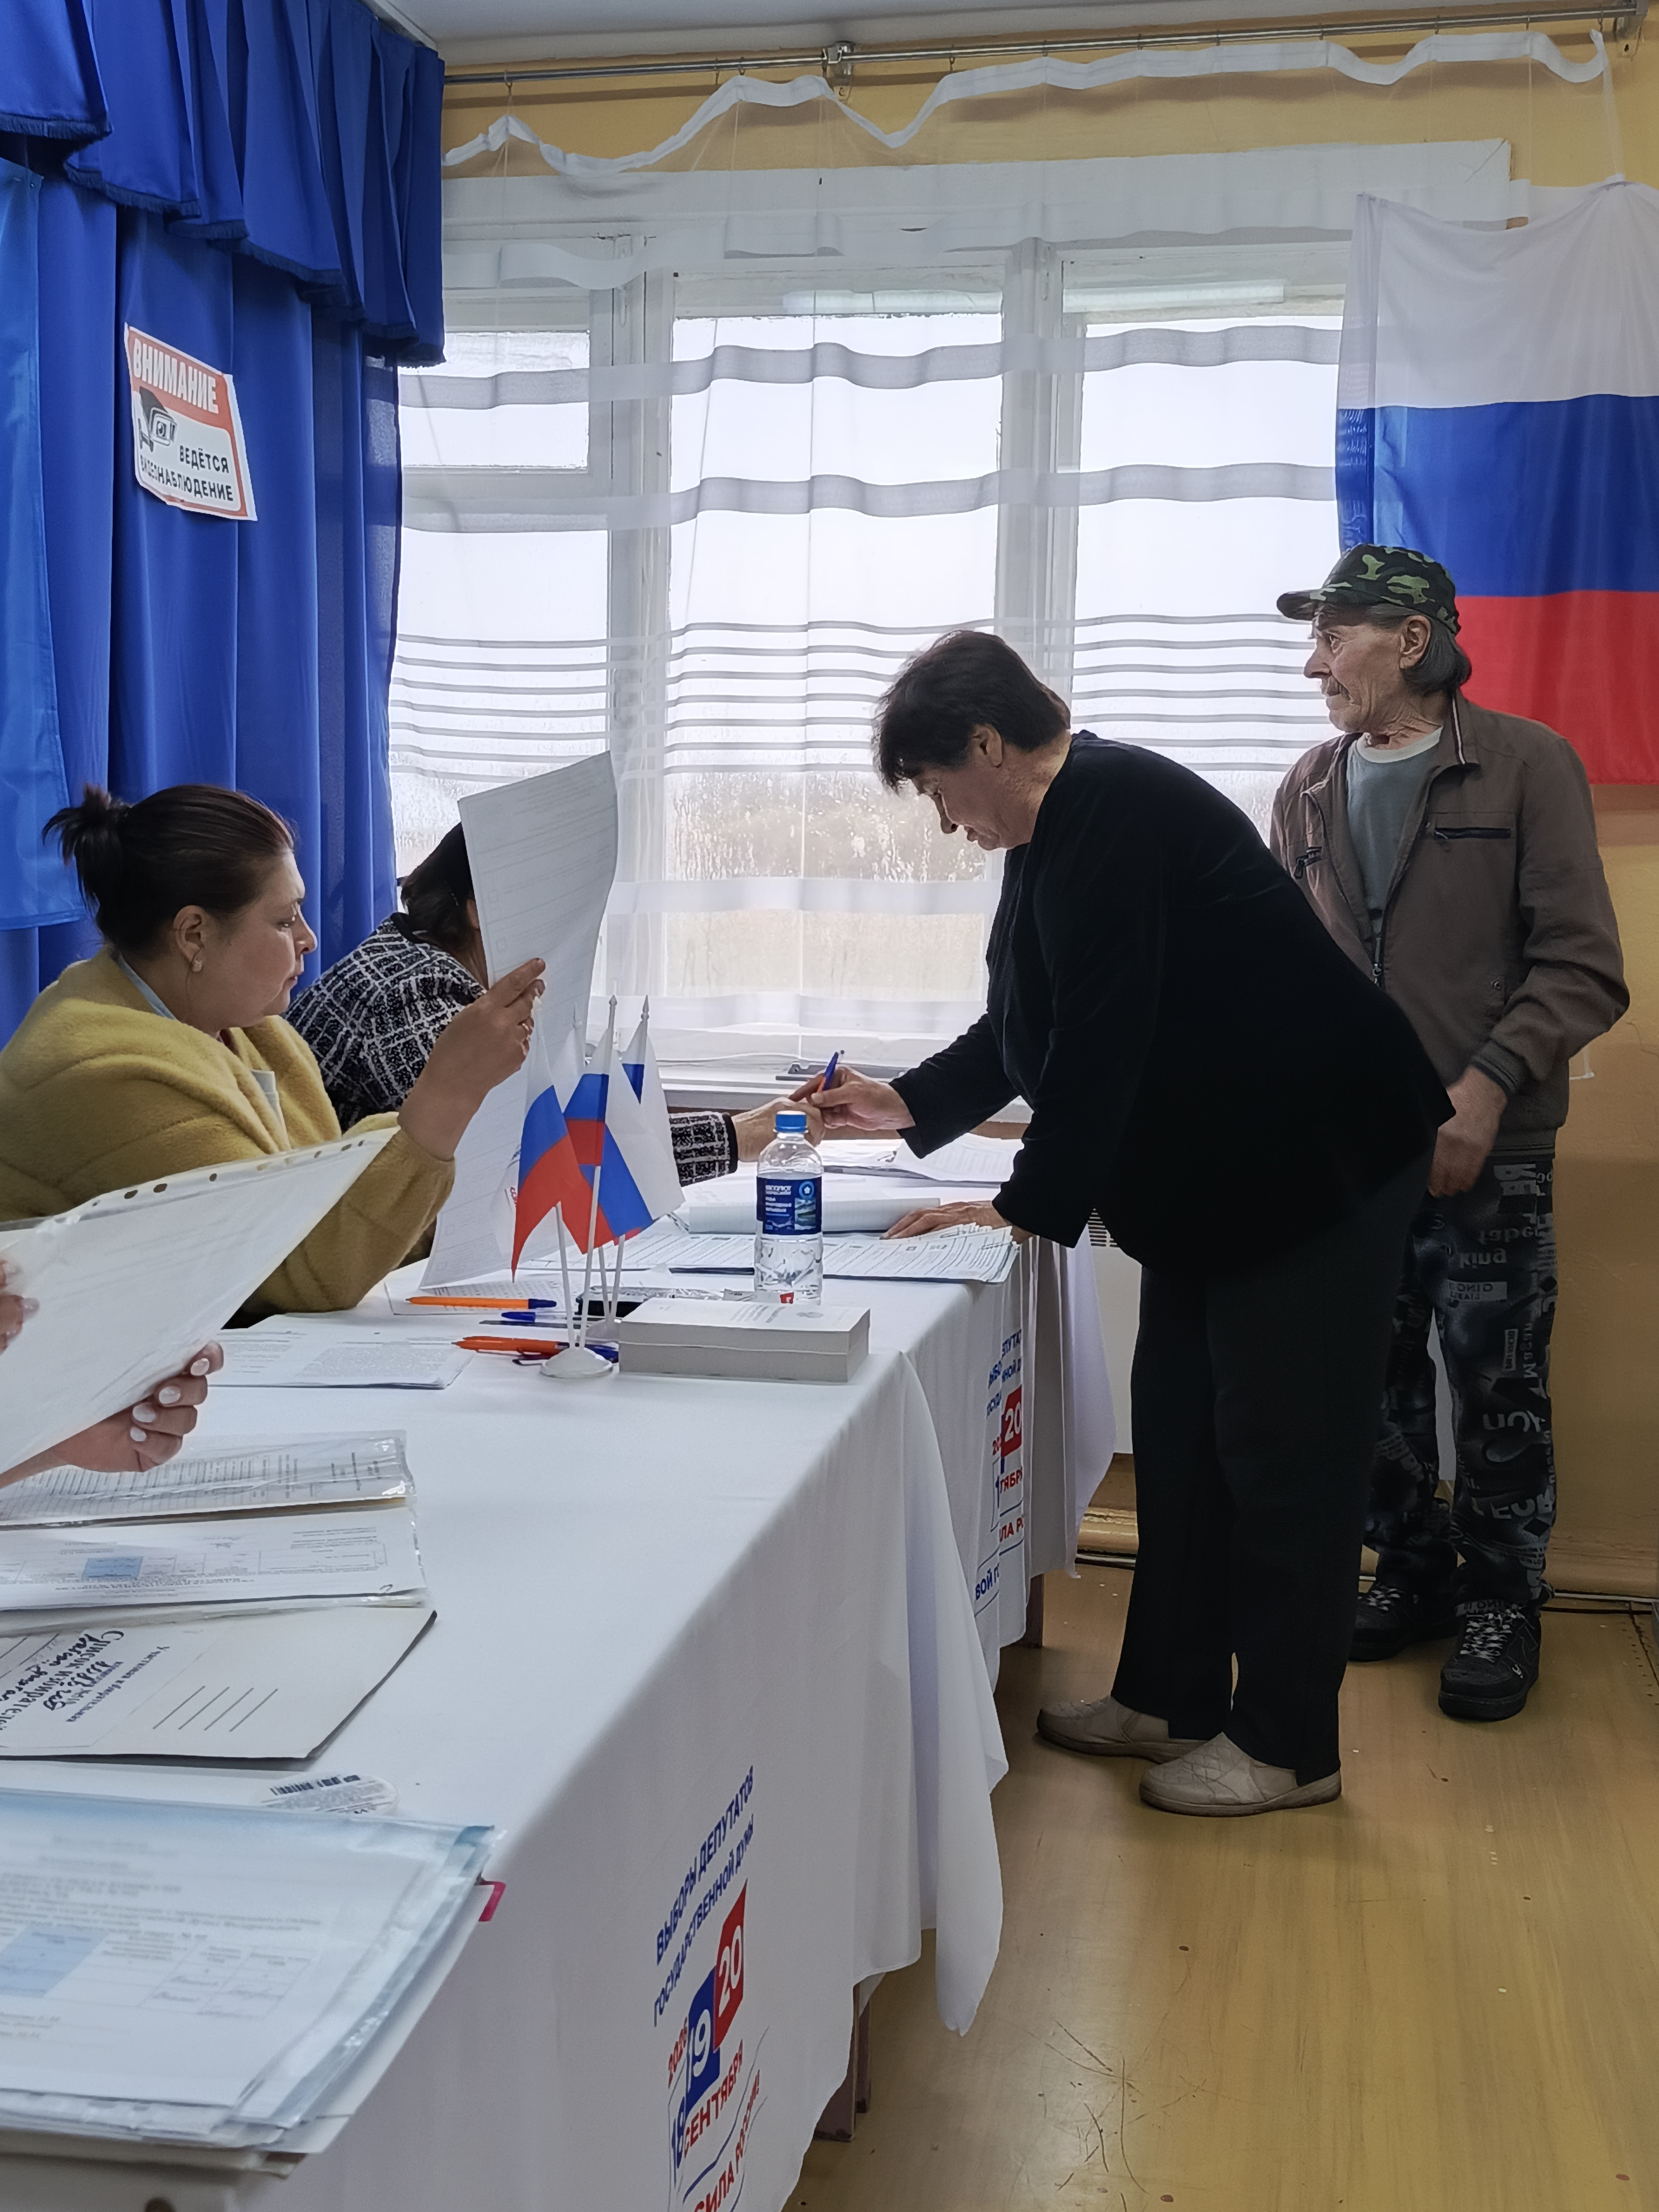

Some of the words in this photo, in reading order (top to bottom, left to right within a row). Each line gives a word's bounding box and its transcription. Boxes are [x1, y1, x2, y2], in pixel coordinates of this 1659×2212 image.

[133, 337, 219, 414] ВНИМАНИЕ
[179, 445, 230, 474] ВЕДЁТСЯ
[1005, 1401, 1022, 1442] 20
[657, 1856, 697, 1966] ВЫБОРЫ
[698, 1765, 753, 1882] ДЕПУТАТОВ
[654, 1848, 735, 2028] ГОСУДАРСТВЕННОЙ
[718, 1924, 742, 2018] 20
[686, 2009, 711, 2094] 19
[684, 2039, 743, 2158] СЕНТЯБРЯ
